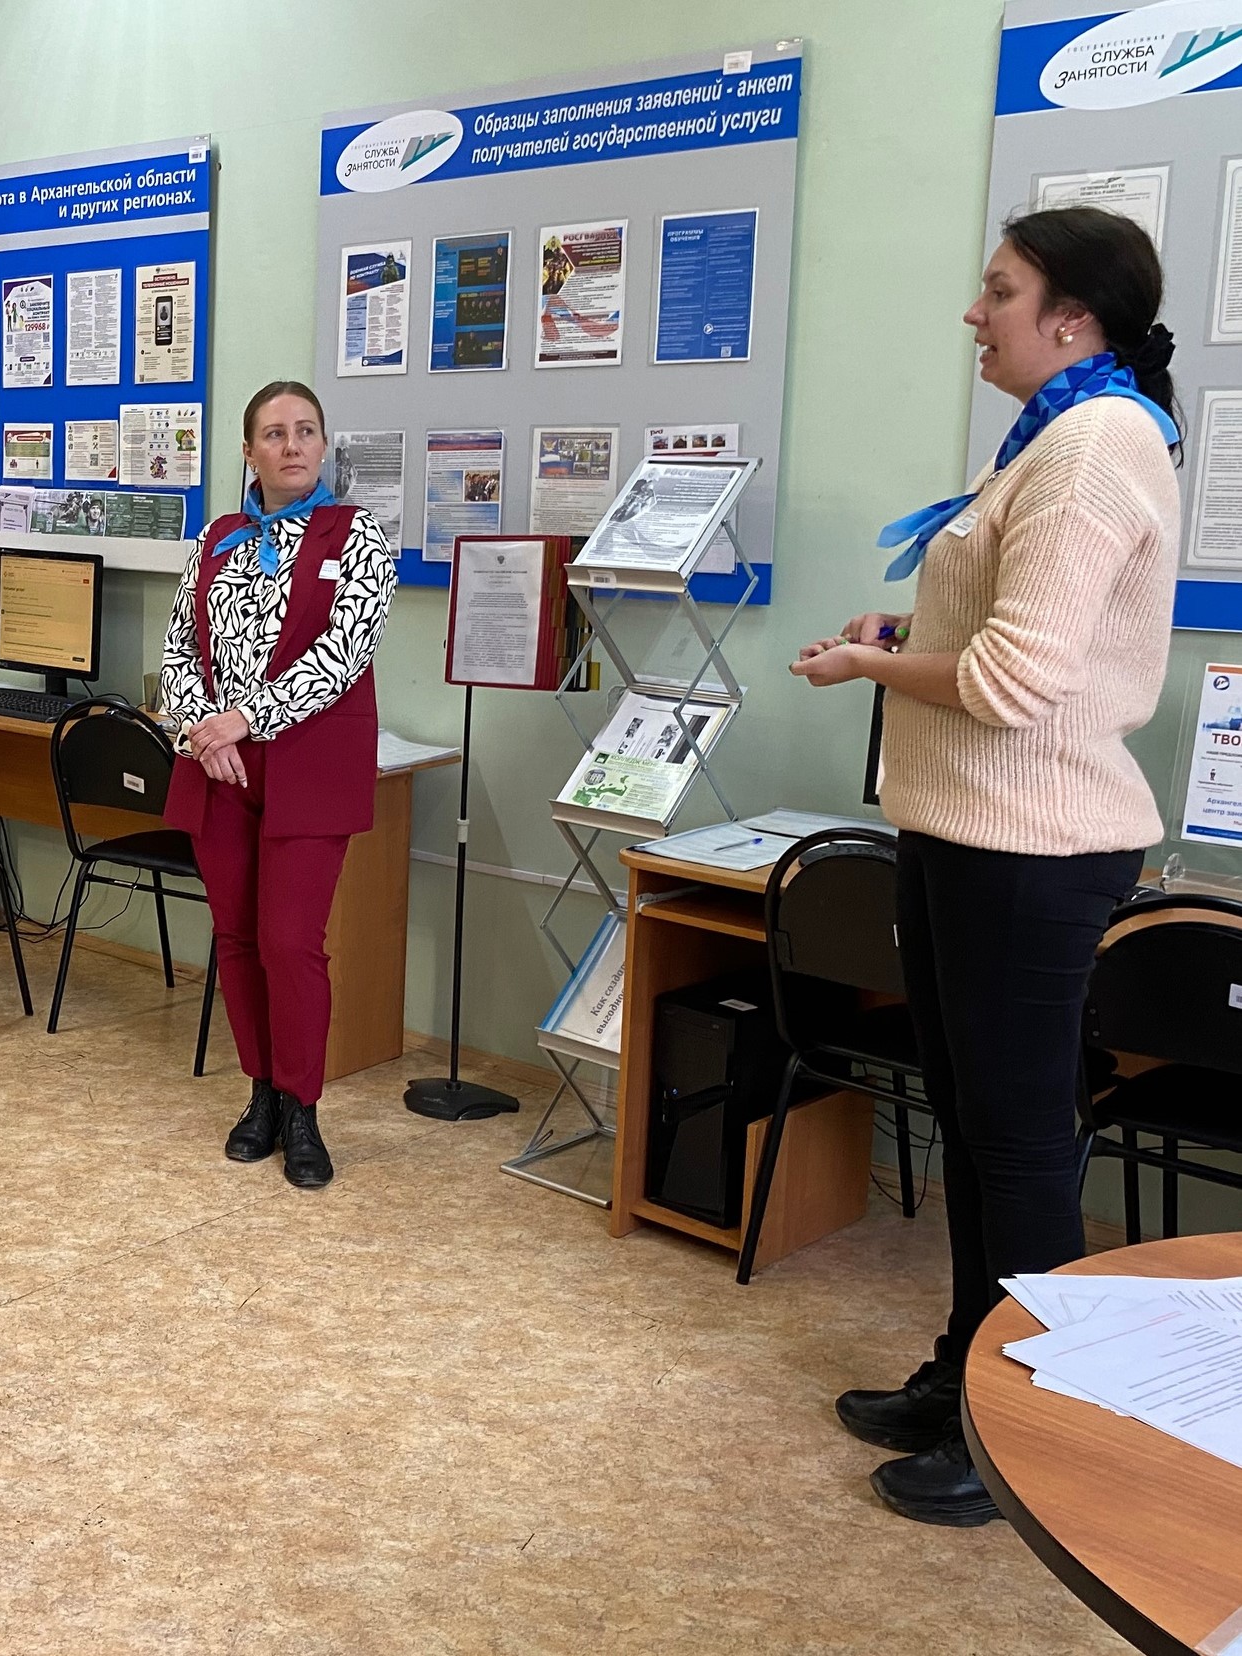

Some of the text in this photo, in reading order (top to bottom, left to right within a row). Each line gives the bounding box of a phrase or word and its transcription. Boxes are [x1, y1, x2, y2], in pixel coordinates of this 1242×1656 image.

[1091, 44, 1155, 64] СЛУЖБА
[1054, 60, 1148, 89] ЗАНЯТОСТИ
[473, 109, 539, 137] Образцы
[542, 96, 633, 123] заполнения
[636, 79, 723, 112] заявлений
[737, 73, 793, 98] анкет
[471, 106, 782, 165] получателей государственной услуги
[344, 158, 396, 177] ЗАНЯТОСТИ
[364, 146, 400, 160] СЛУЖБА
[19, 192, 27, 202] в
[31, 172, 132, 205] Архангельской
[137, 168, 197, 189] области
[58, 189, 196, 220] и других регионах.
[590, 996, 608, 1017] Как
